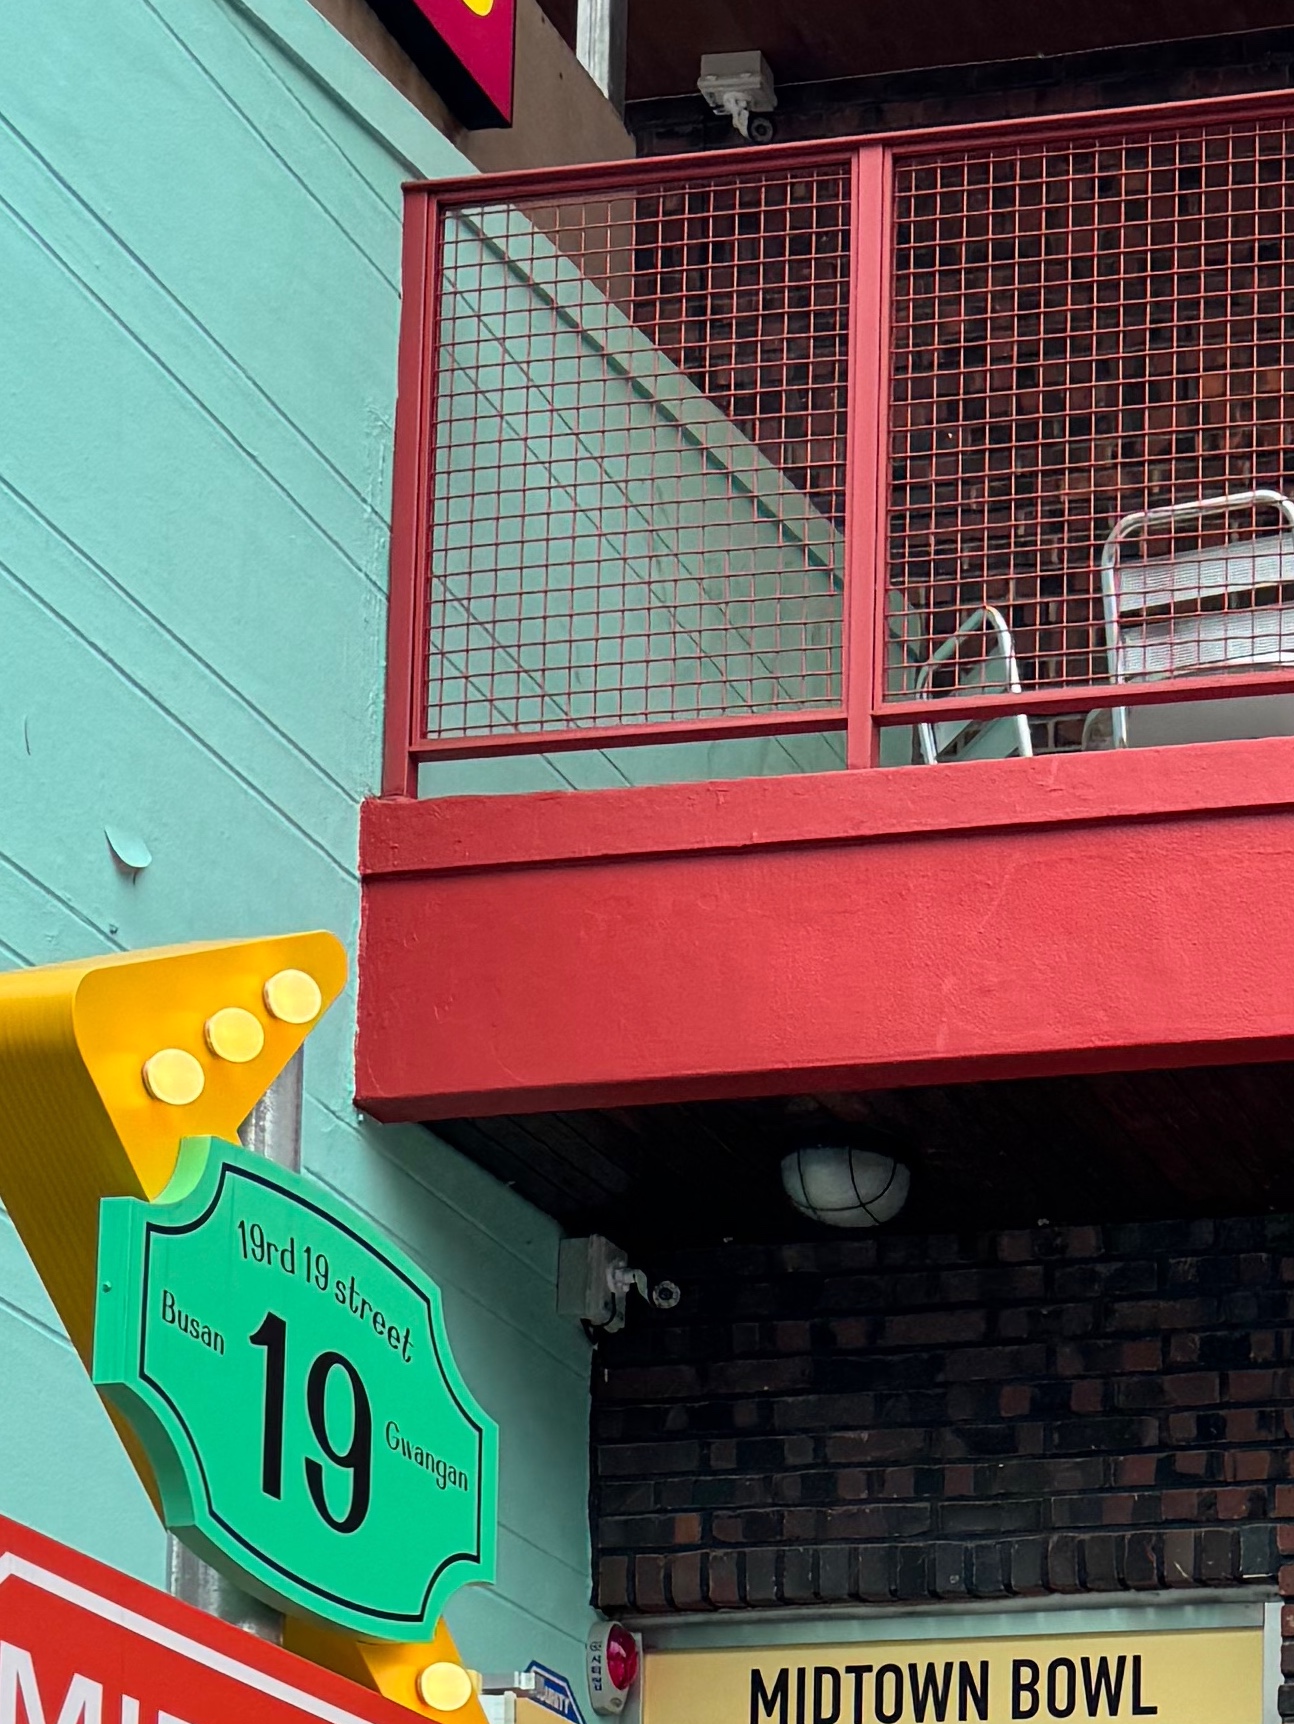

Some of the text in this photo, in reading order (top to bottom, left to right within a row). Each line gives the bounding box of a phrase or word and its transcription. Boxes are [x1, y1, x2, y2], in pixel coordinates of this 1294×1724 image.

[161, 1289, 226, 1356] Busan
[237, 1220, 415, 1365] 19rd 19 street
[248, 1310, 373, 1535] 19
[1011, 1655, 1158, 1720] BOWL
